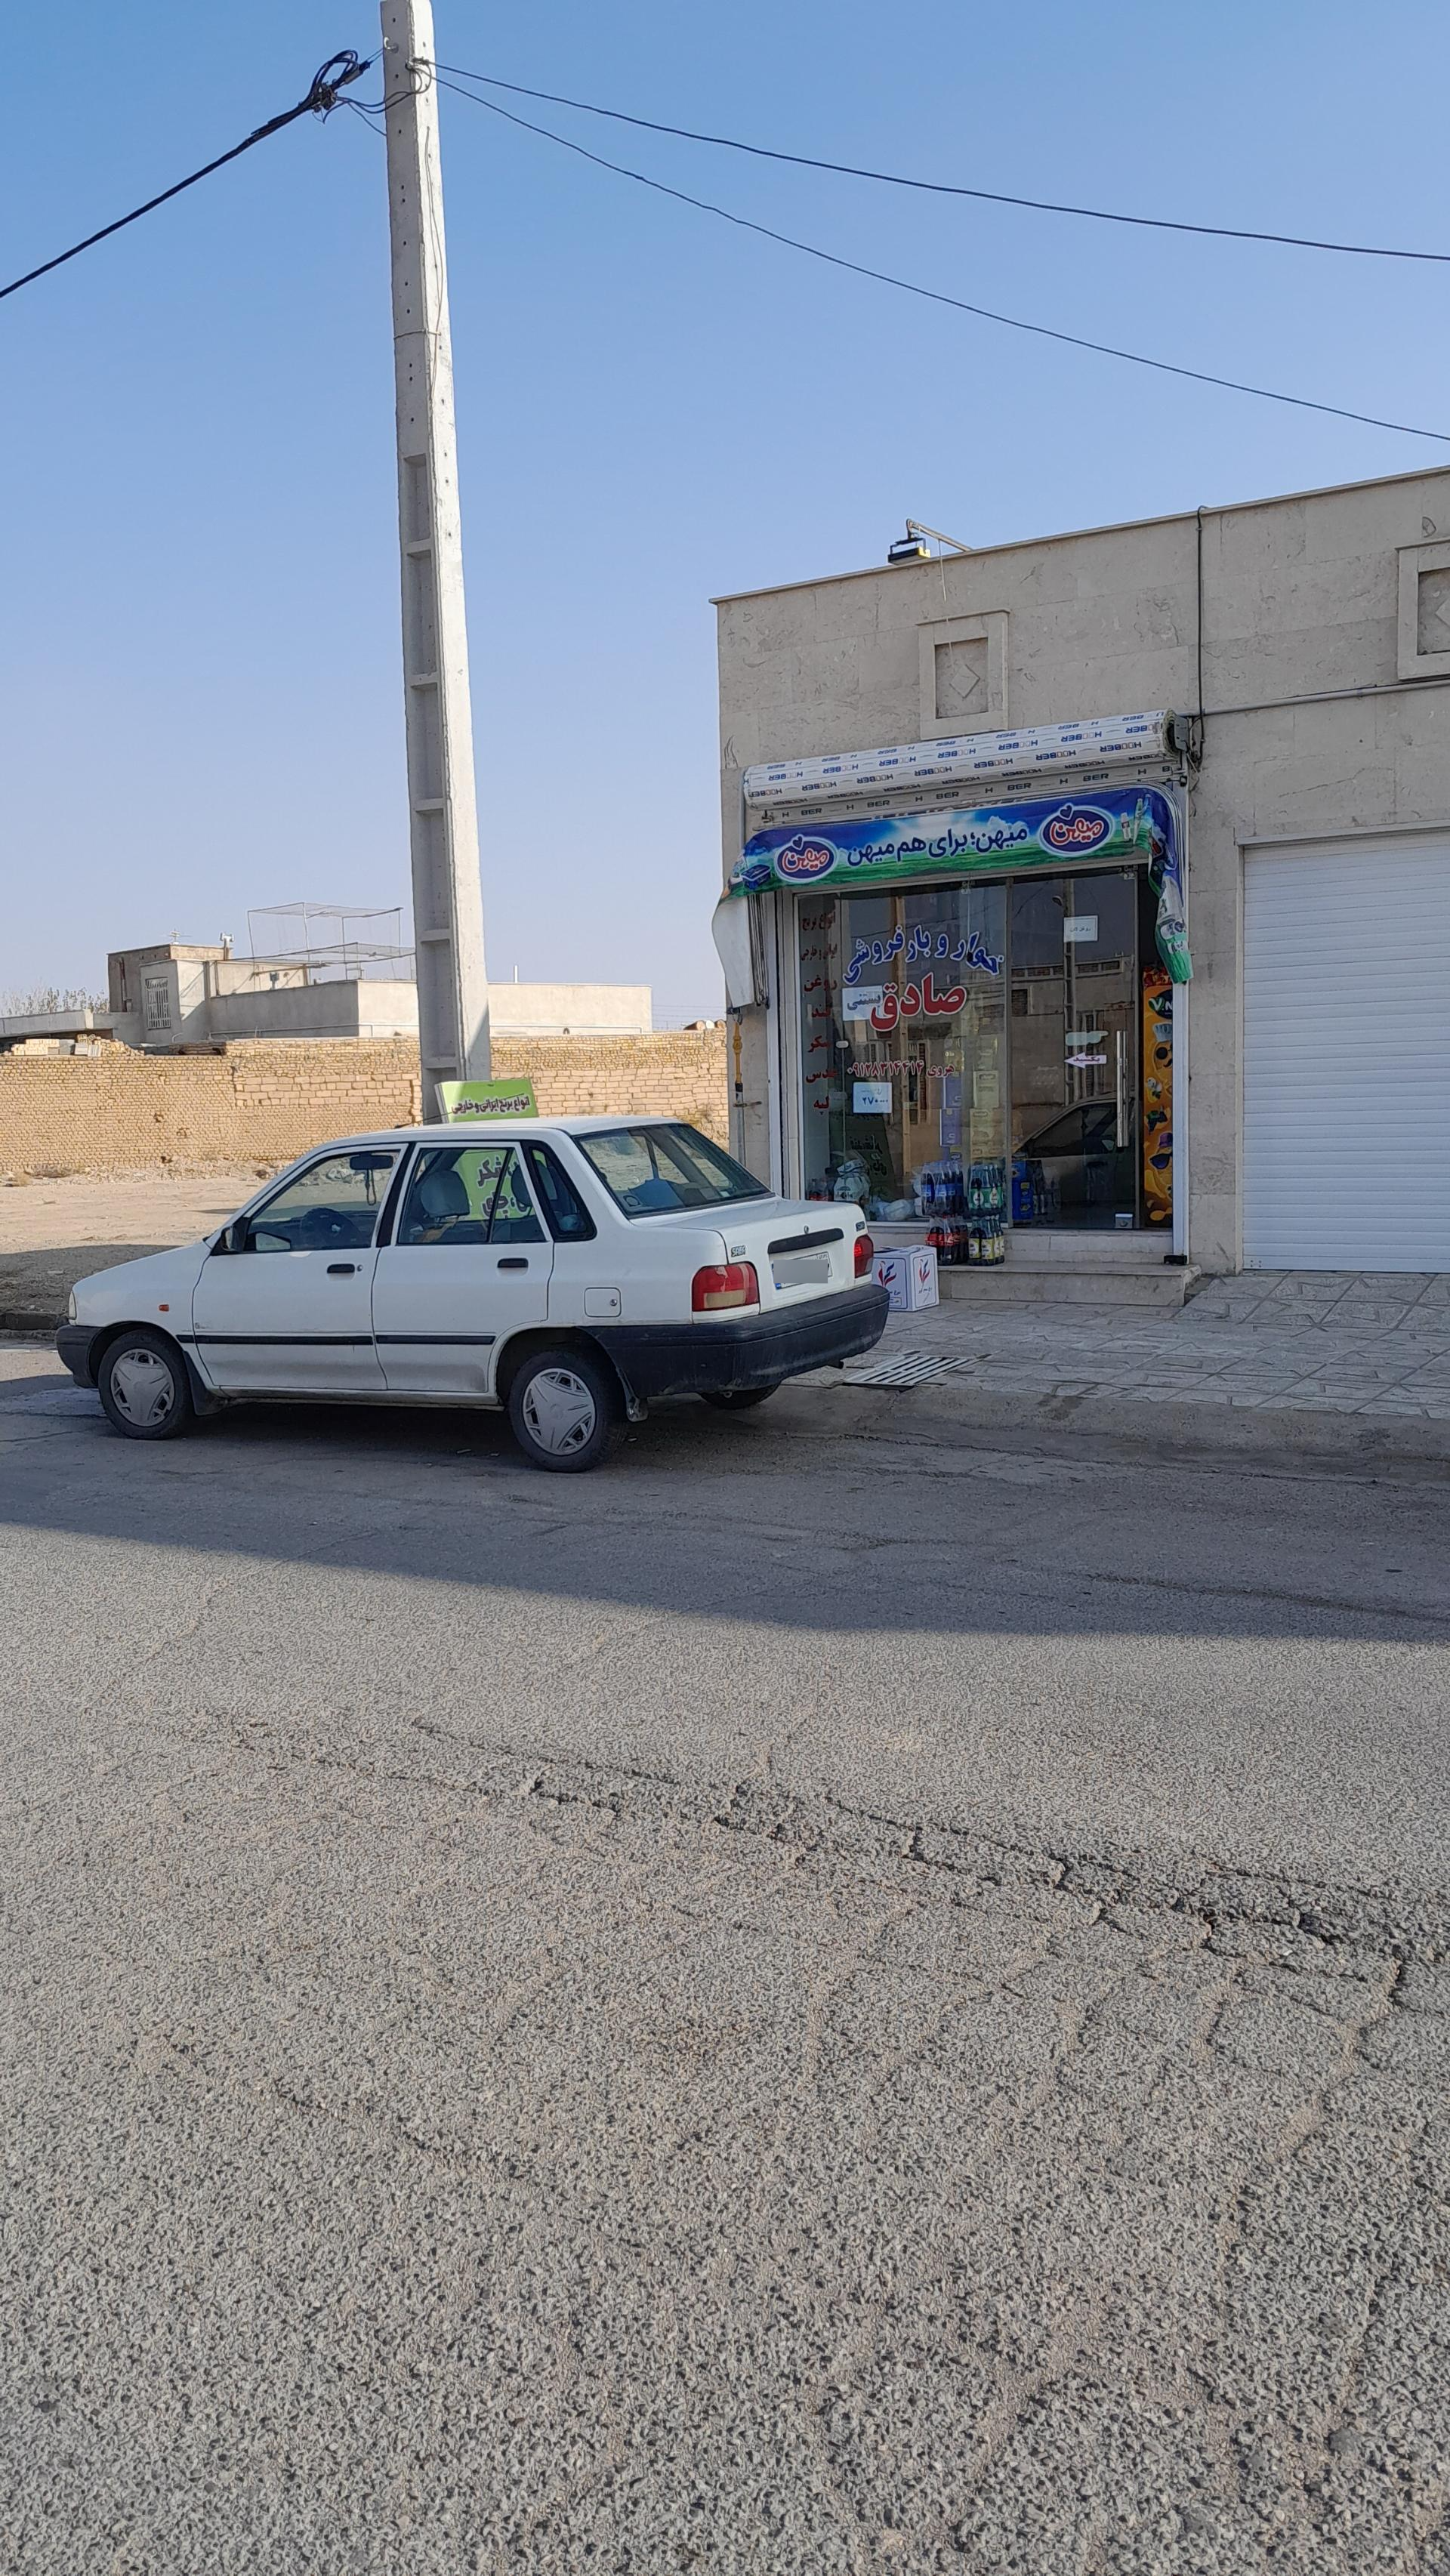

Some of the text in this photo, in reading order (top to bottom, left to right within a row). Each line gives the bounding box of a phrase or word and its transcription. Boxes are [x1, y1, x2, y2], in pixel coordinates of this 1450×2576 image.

[928, 828, 967, 857] برای
[1050, 818, 1104, 845] میهن
[782, 848, 829, 872] میهن
[804, 975, 837, 992] روغن
[870, 972, 967, 1032] صادق
[1148, 997, 1173, 1010] V.N
[514, 1096, 529, 1111] انواع
